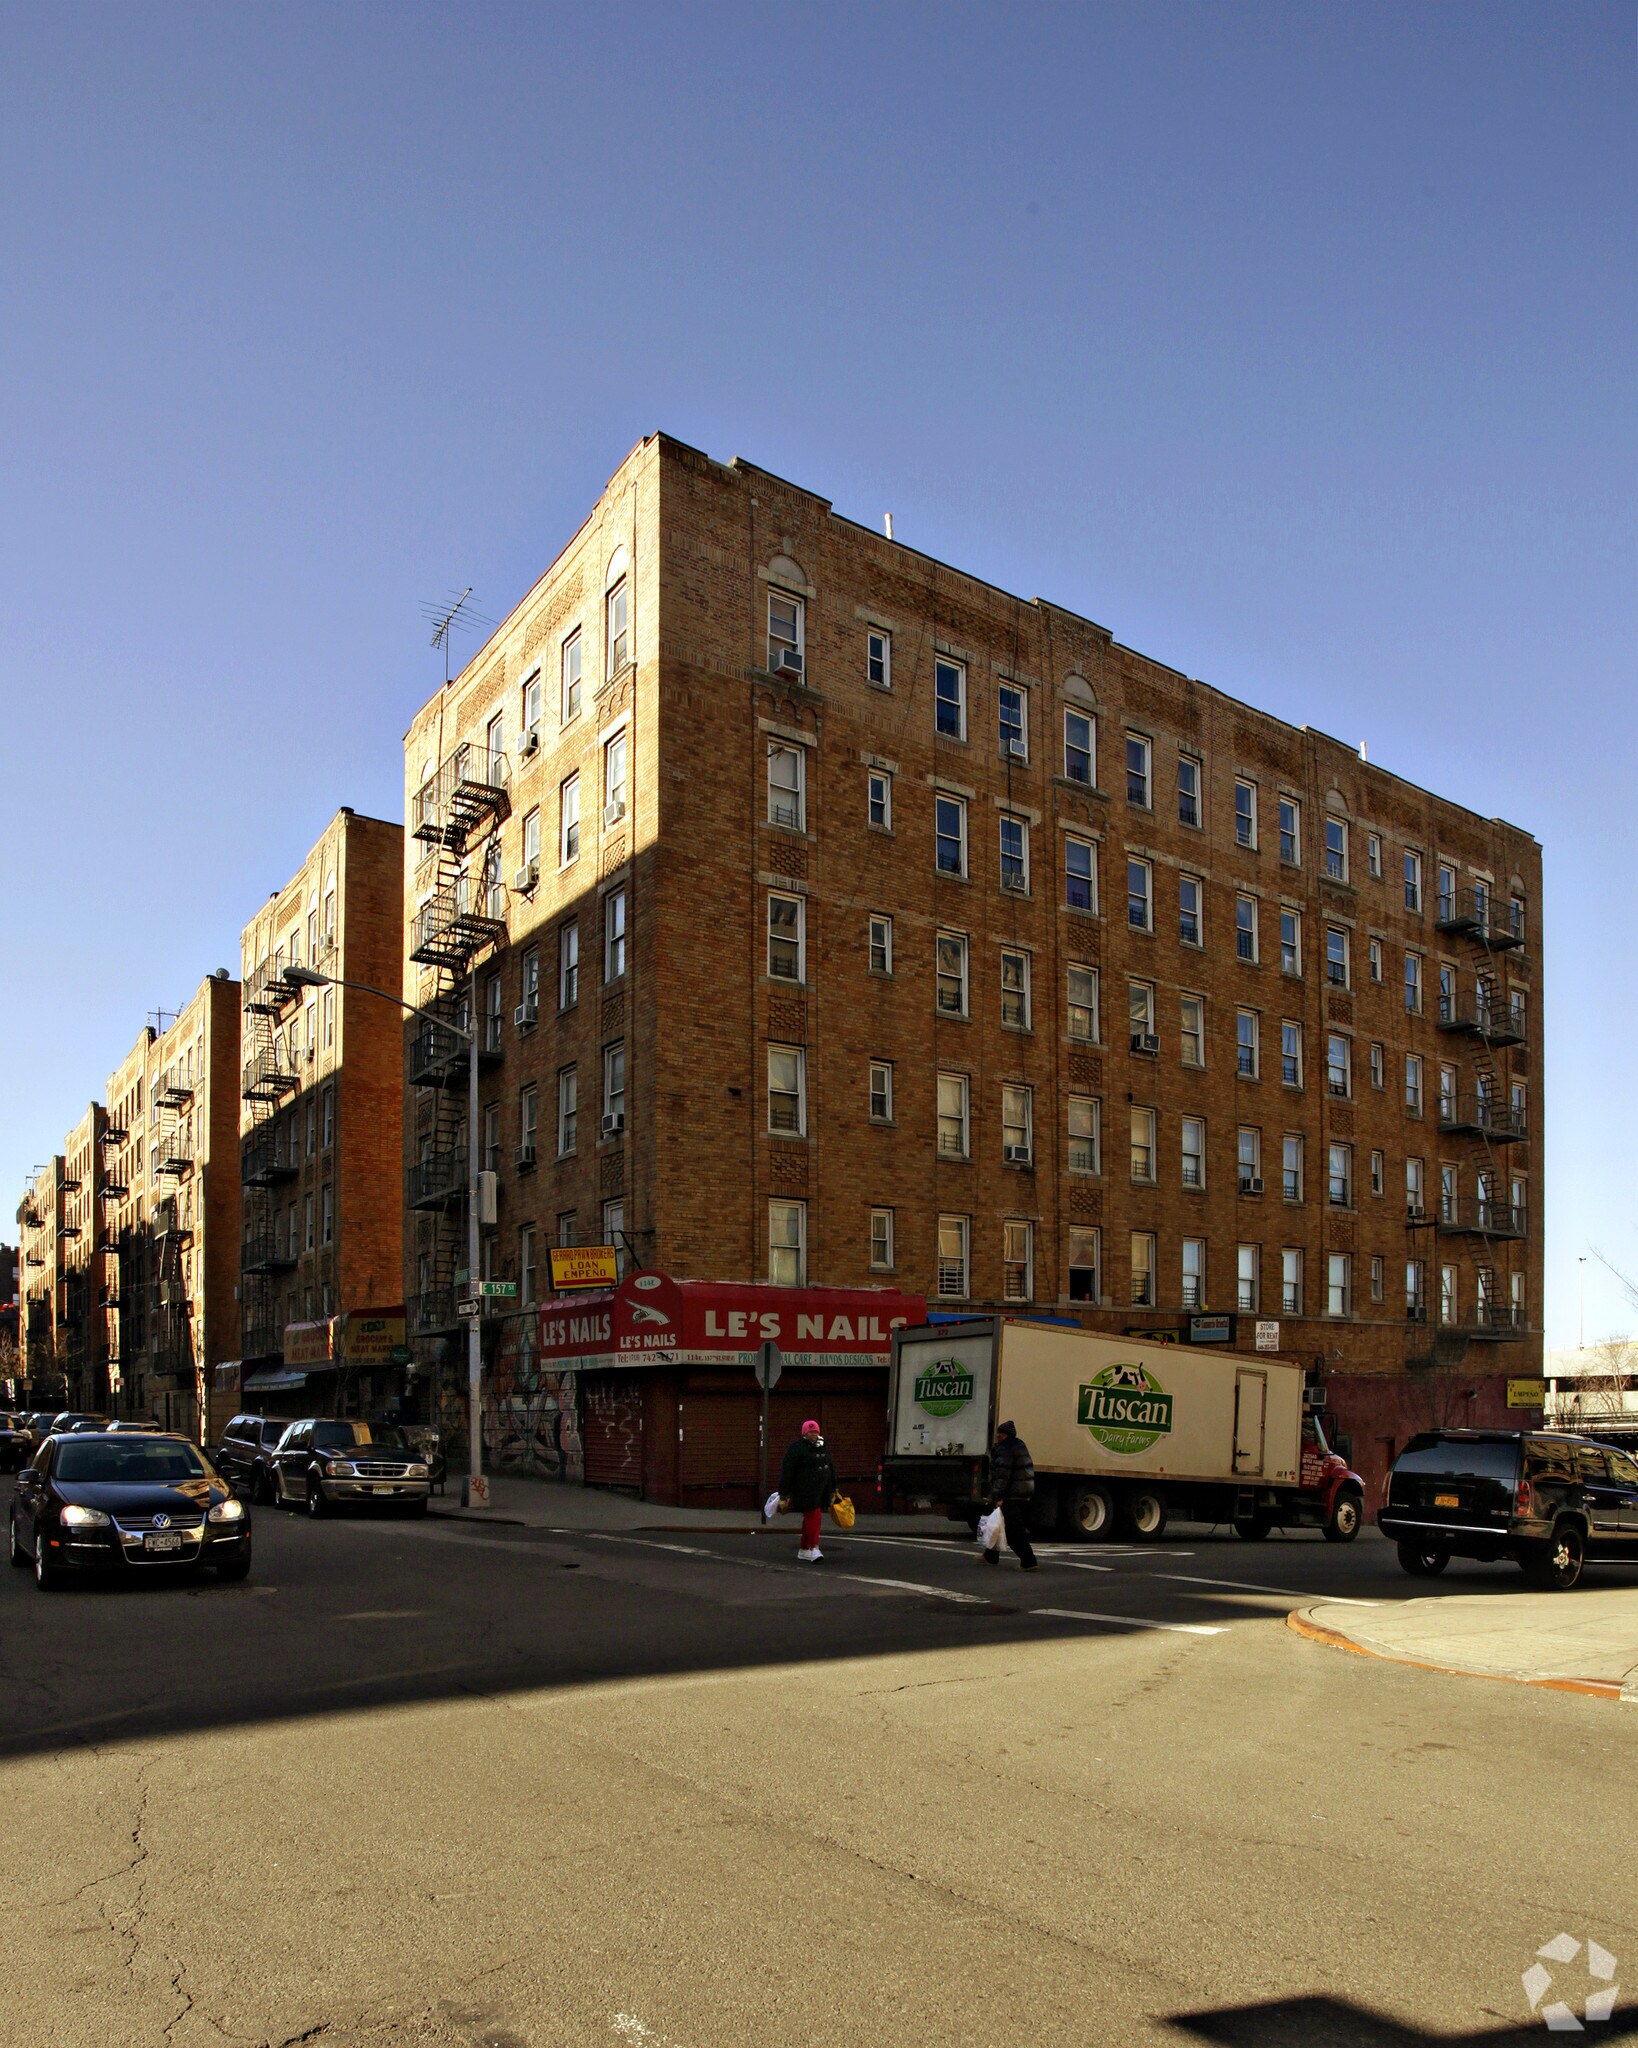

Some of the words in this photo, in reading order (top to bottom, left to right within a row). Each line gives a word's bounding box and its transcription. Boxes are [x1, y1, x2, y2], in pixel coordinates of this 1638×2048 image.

[570, 1261, 598, 1270] LOAN
[483, 1284, 488, 1294] E
[492, 1284, 506, 1294] 157
[543, 1319, 566, 1346] LE'S
[570, 1313, 611, 1344] NAILS
[705, 1309, 782, 1339] LE'S
[1260, 1323, 1275, 1331] STORE
[620, 1336, 640, 1348] LE'S
[644, 1333, 676, 1348] NAILS
[794, 1354, 812, 1364] CARE
[820, 1354, 842, 1365] HANDS
[845, 1354, 874, 1366] DESIGNS
[918, 1379, 970, 1399] Tuscan
[1084, 1388, 1168, 1425] Tuscan
[1098, 1428, 1126, 1447] Dairy
[1126, 1432, 1151, 1447] Farms
